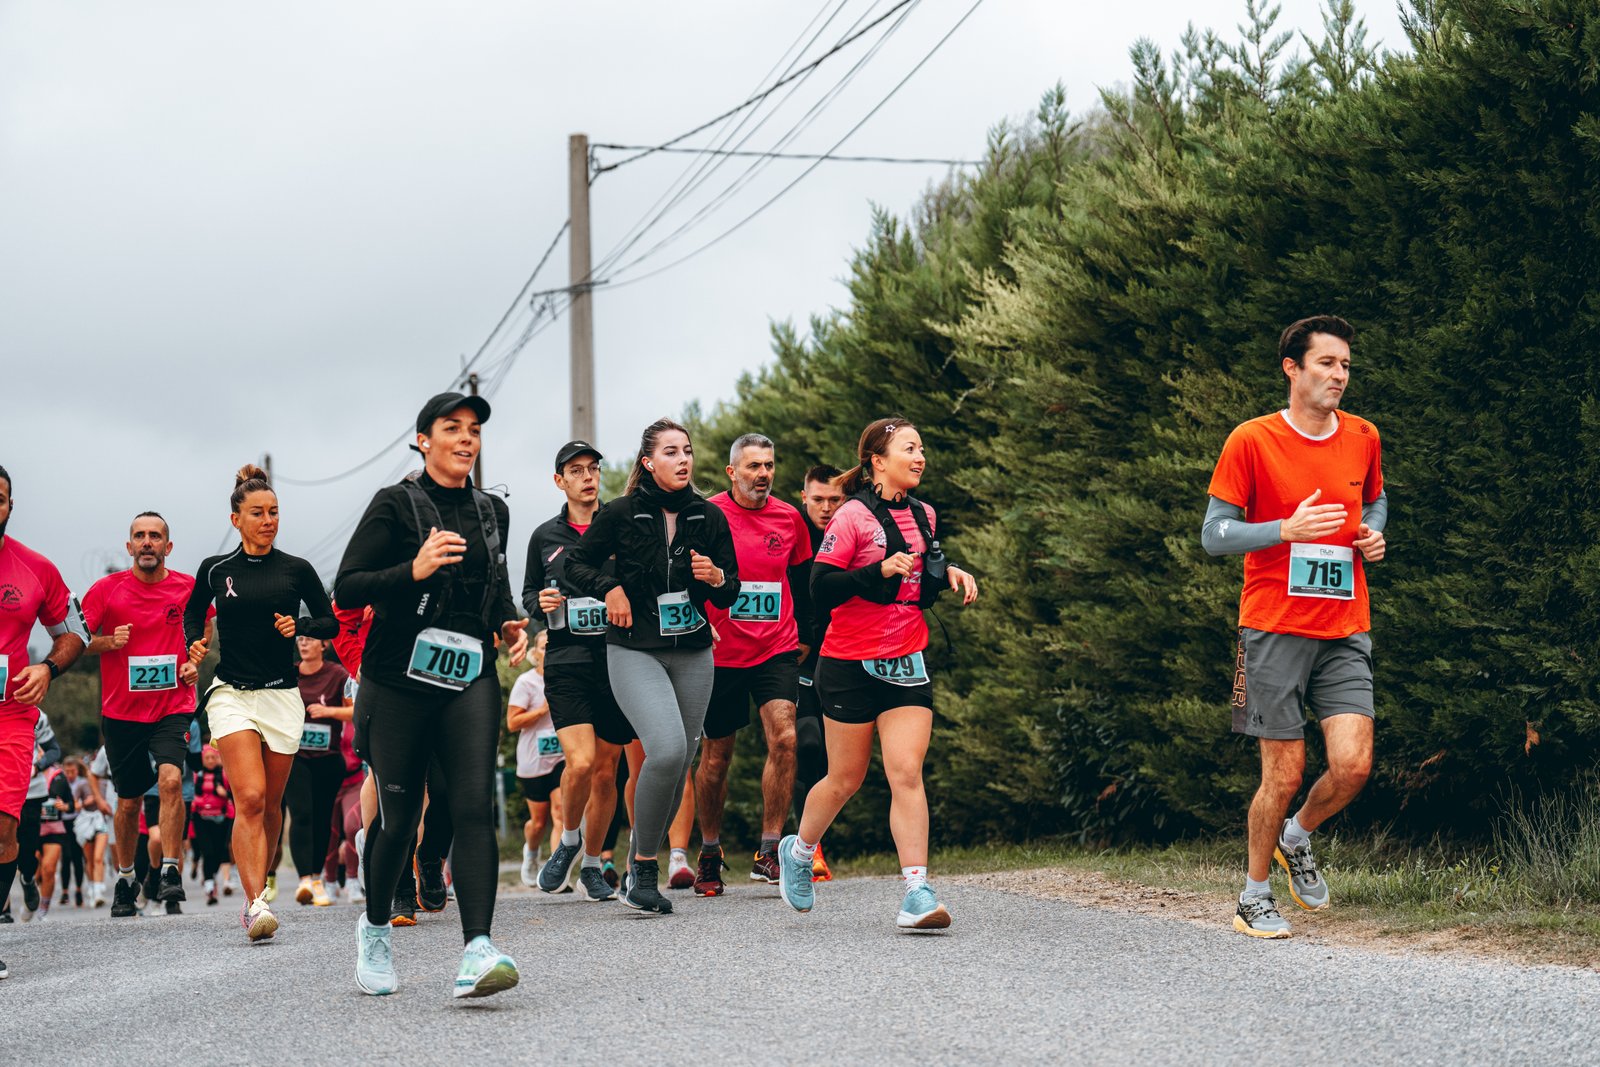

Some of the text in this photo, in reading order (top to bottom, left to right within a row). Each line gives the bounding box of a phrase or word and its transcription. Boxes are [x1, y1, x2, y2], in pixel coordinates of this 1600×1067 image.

[1307, 560, 1342, 588] 715
[737, 594, 775, 613] 210
[667, 605, 698, 626] 39
[426, 645, 470, 679] 709
[874, 655, 915, 677] 629
[135, 665, 169, 683] 221
[264, 678, 284, 688] KIPRUN
